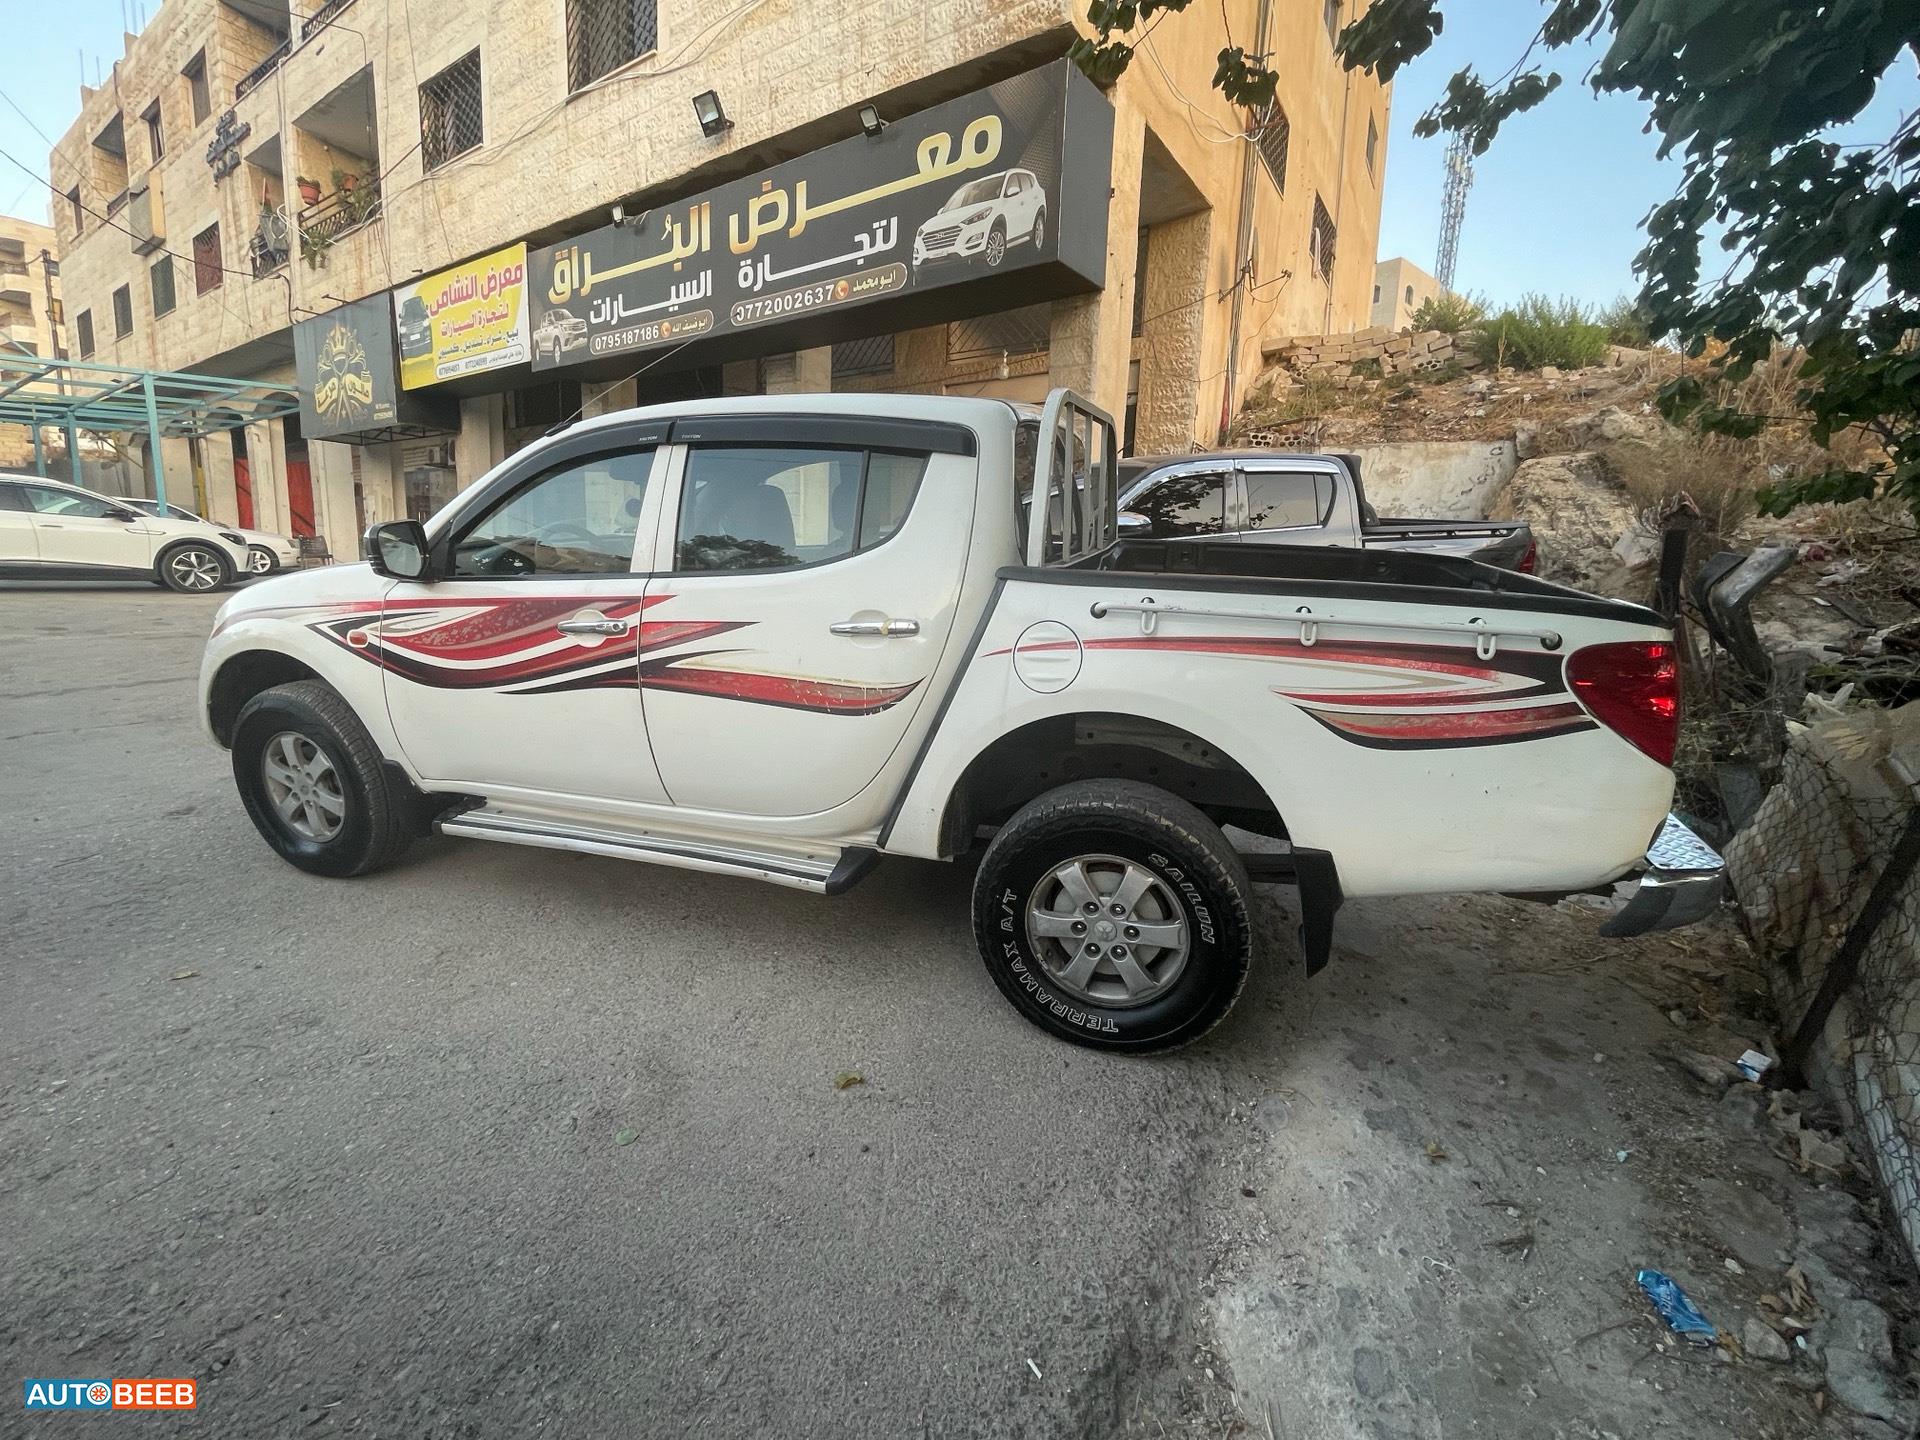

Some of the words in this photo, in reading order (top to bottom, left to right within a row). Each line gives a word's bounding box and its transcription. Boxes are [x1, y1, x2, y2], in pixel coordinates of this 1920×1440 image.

[729, 115, 1003, 255] معرض
[738, 215, 898, 292] لتجارة
[480, 263, 523, 301] معرض
[589, 269, 712, 326] السيارات
[853, 277, 879, 293] محمد
[478, 303, 509, 329] لتجارة
[736, 284, 835, 322] 0772002637
[440, 313, 476, 338] السيارات
[595, 325, 659, 351] 0795187186
[1000, 888, 1017, 932] A/T
[1149, 853, 1215, 944] SAILUN
[1004, 940, 1119, 1033] TERRAMAX
